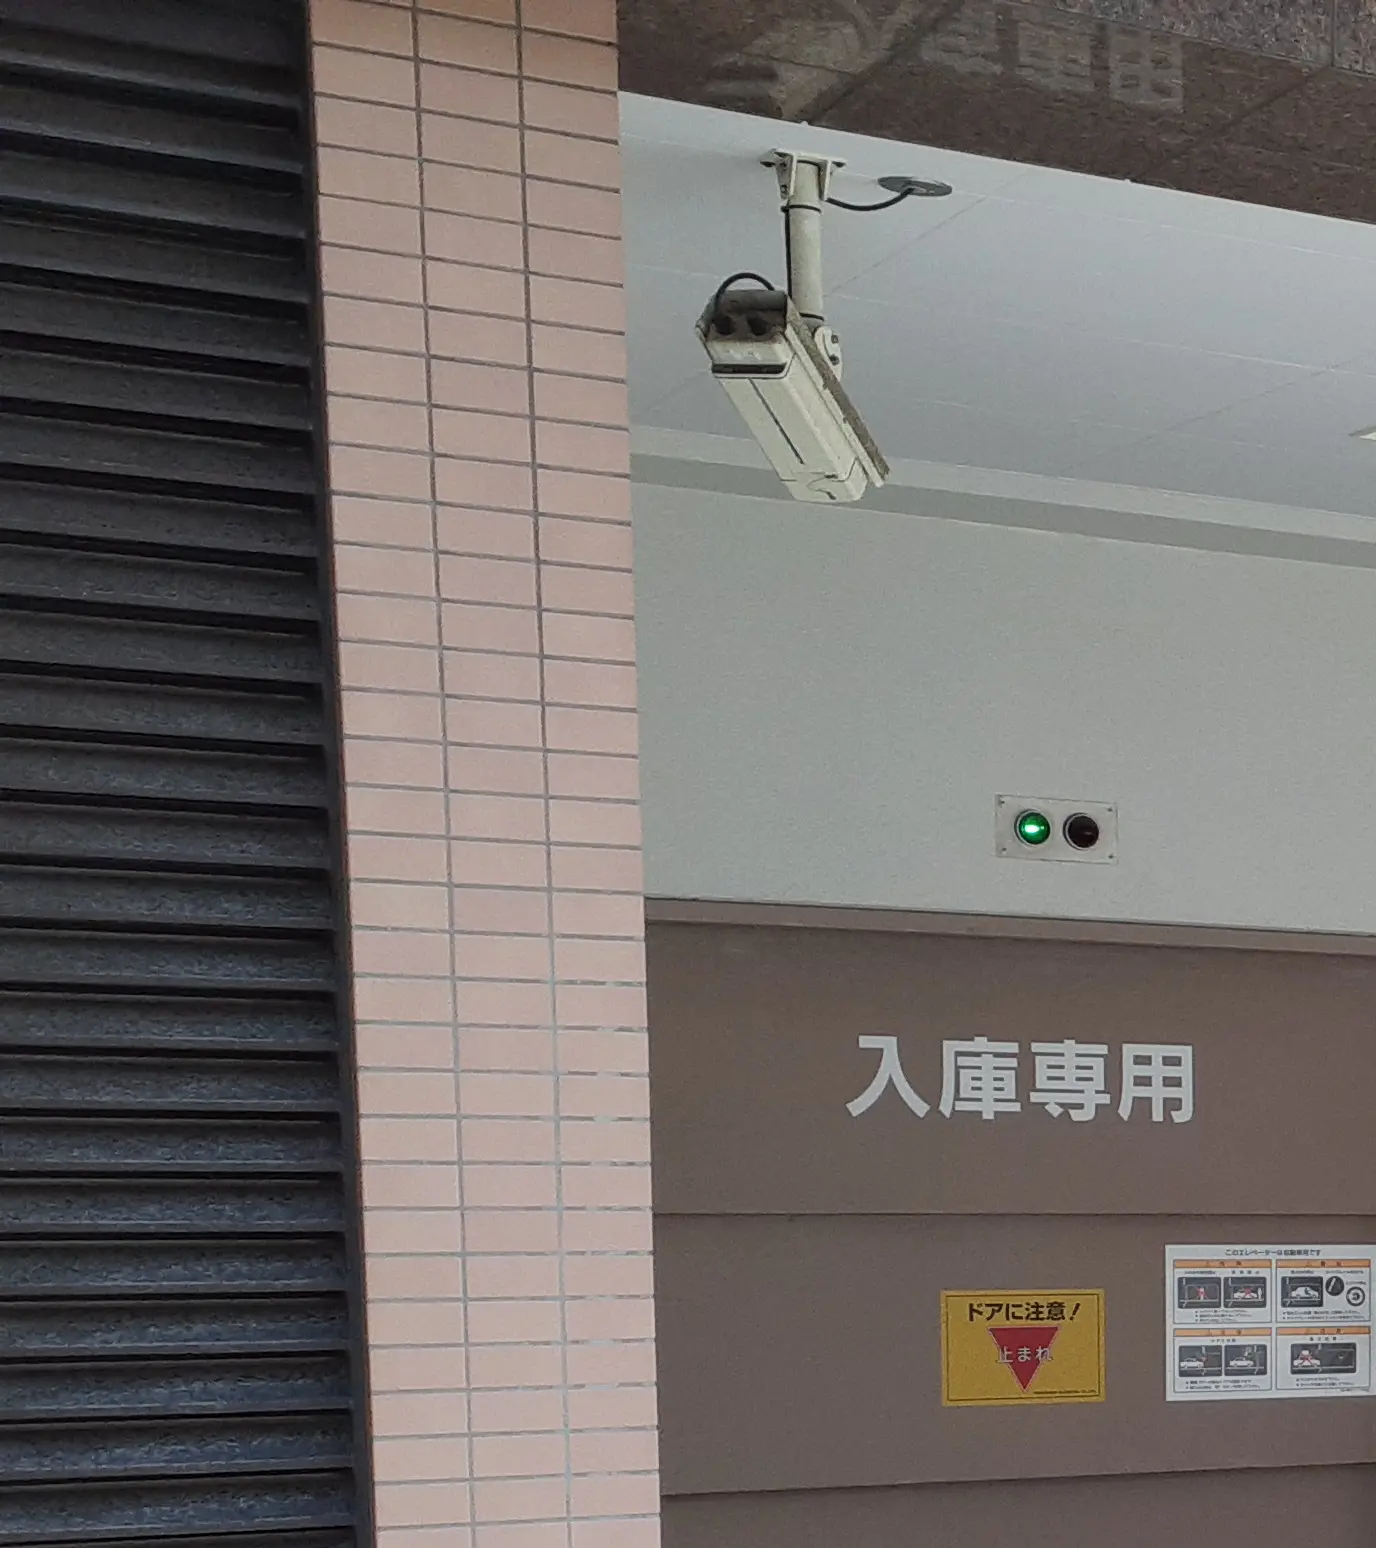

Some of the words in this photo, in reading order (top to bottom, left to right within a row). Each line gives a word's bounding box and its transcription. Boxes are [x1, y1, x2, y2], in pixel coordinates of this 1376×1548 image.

[846, 1034, 1196, 1124] 入庫専用
[968, 1301, 1081, 1322] ドアに注意!
[996, 1345, 1053, 1364] 止まれ
